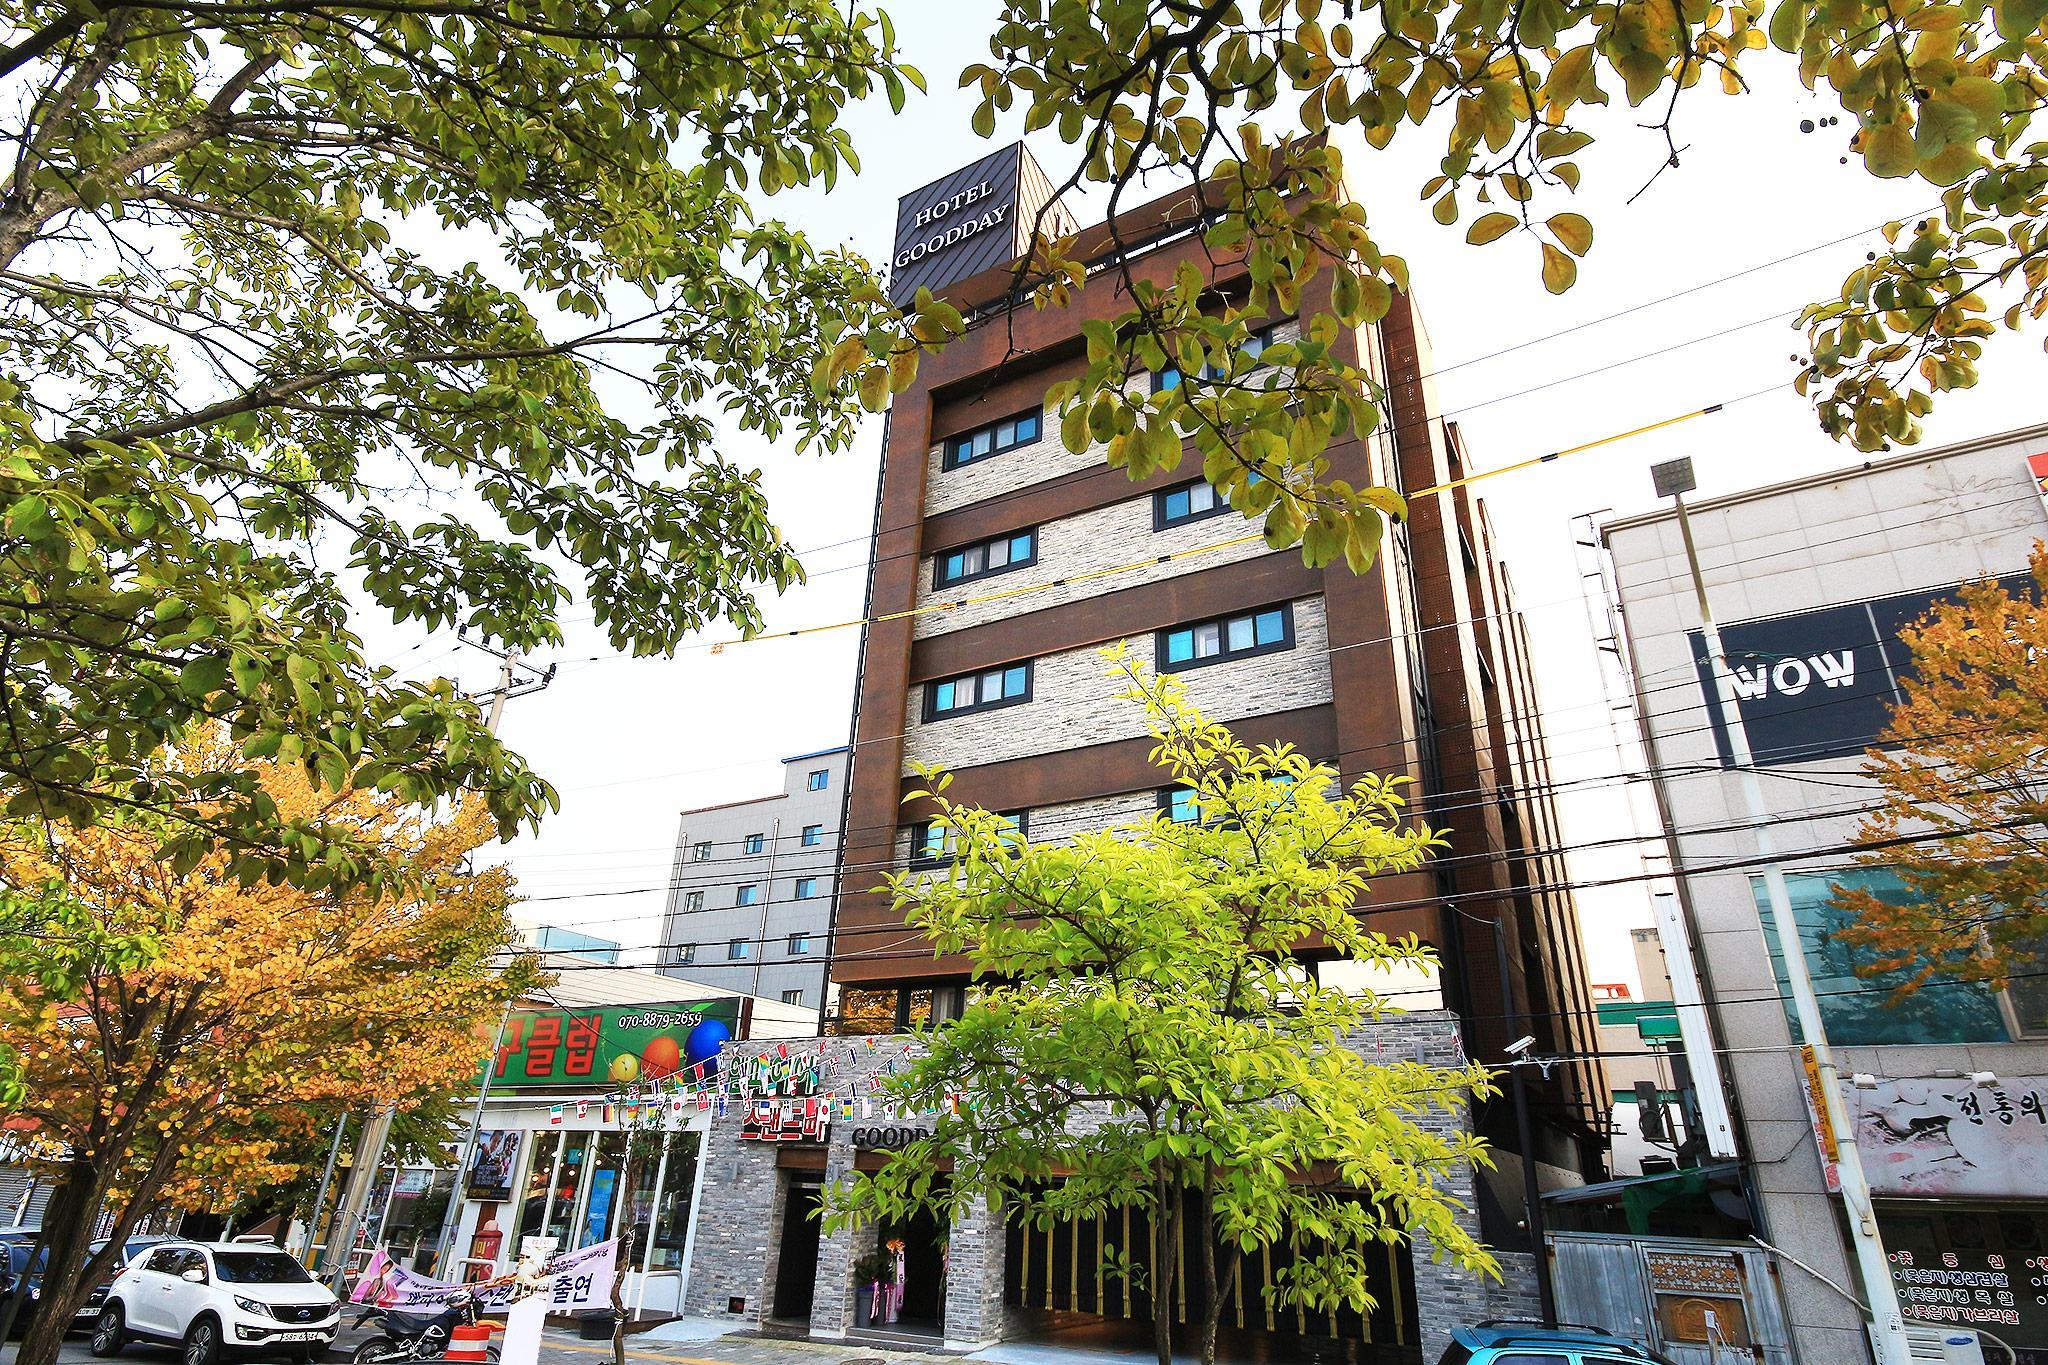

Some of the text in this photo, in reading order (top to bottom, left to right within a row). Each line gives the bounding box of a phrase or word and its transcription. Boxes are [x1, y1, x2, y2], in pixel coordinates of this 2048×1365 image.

[915, 180, 993, 228] HOTEL
[895, 203, 1010, 268] GOODDAY
[1728, 650, 1855, 700] WOW
[617, 1010, 703, 1031] 070-8879-2659
[552, 1272, 595, 1304] 출연
